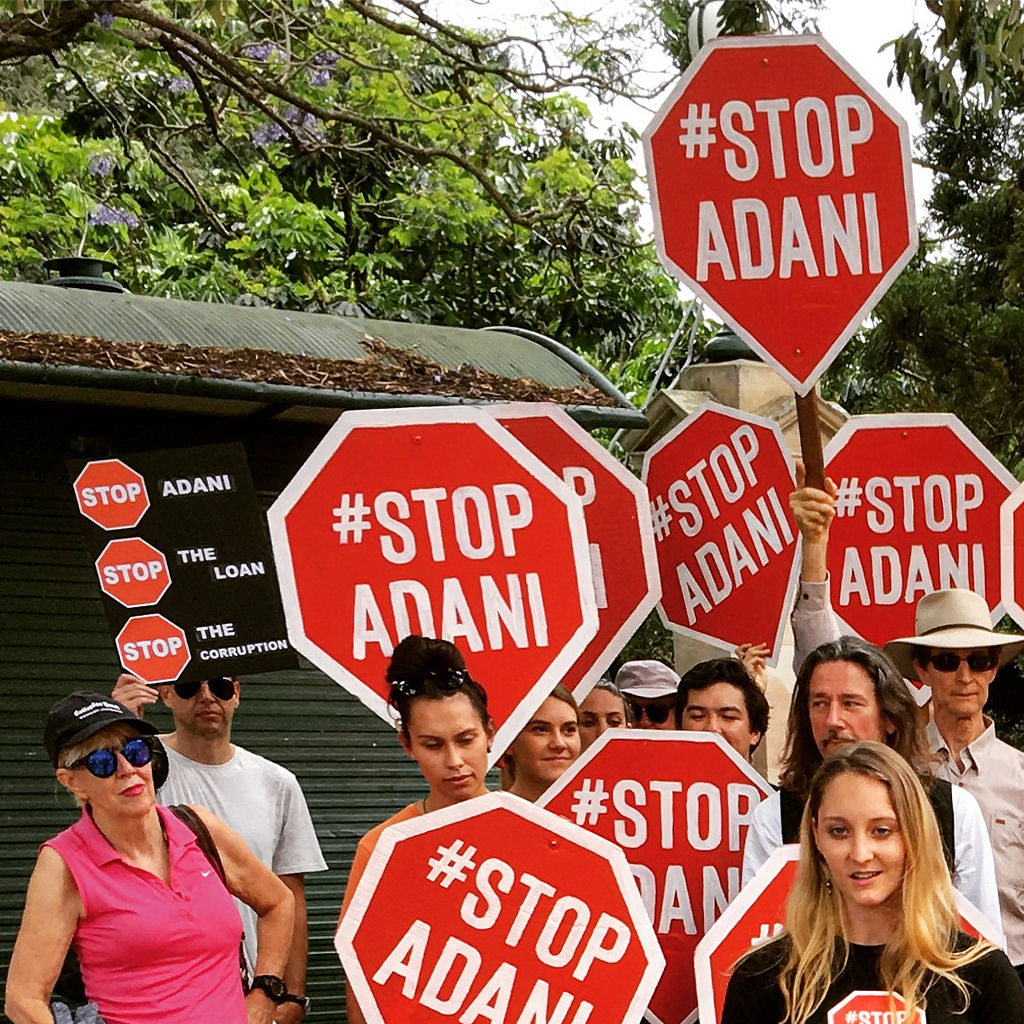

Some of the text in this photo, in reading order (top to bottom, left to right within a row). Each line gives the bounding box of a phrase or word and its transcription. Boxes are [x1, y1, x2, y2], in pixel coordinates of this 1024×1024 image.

[679, 95, 874, 181] #STOP
[696, 192, 883, 281] ADANI
[81, 475, 231, 507] STOP ADANI
[650, 422, 761, 542] #STOP
[834, 473, 984, 533] #STOP
[332, 483, 533, 565] #STOP
[674, 486, 794, 626] ADANI
[103, 547, 217, 585] STOP THE
[214, 561, 266, 580] LOAN
[839, 543, 986, 607] ADANI
[125, 623, 235, 661] STOP THE
[200, 639, 288, 661] CORRUPTION
[353, 572, 549, 660] ADANI
[571, 778, 760, 851] #STOP
[426, 839, 631, 982] #STOP
